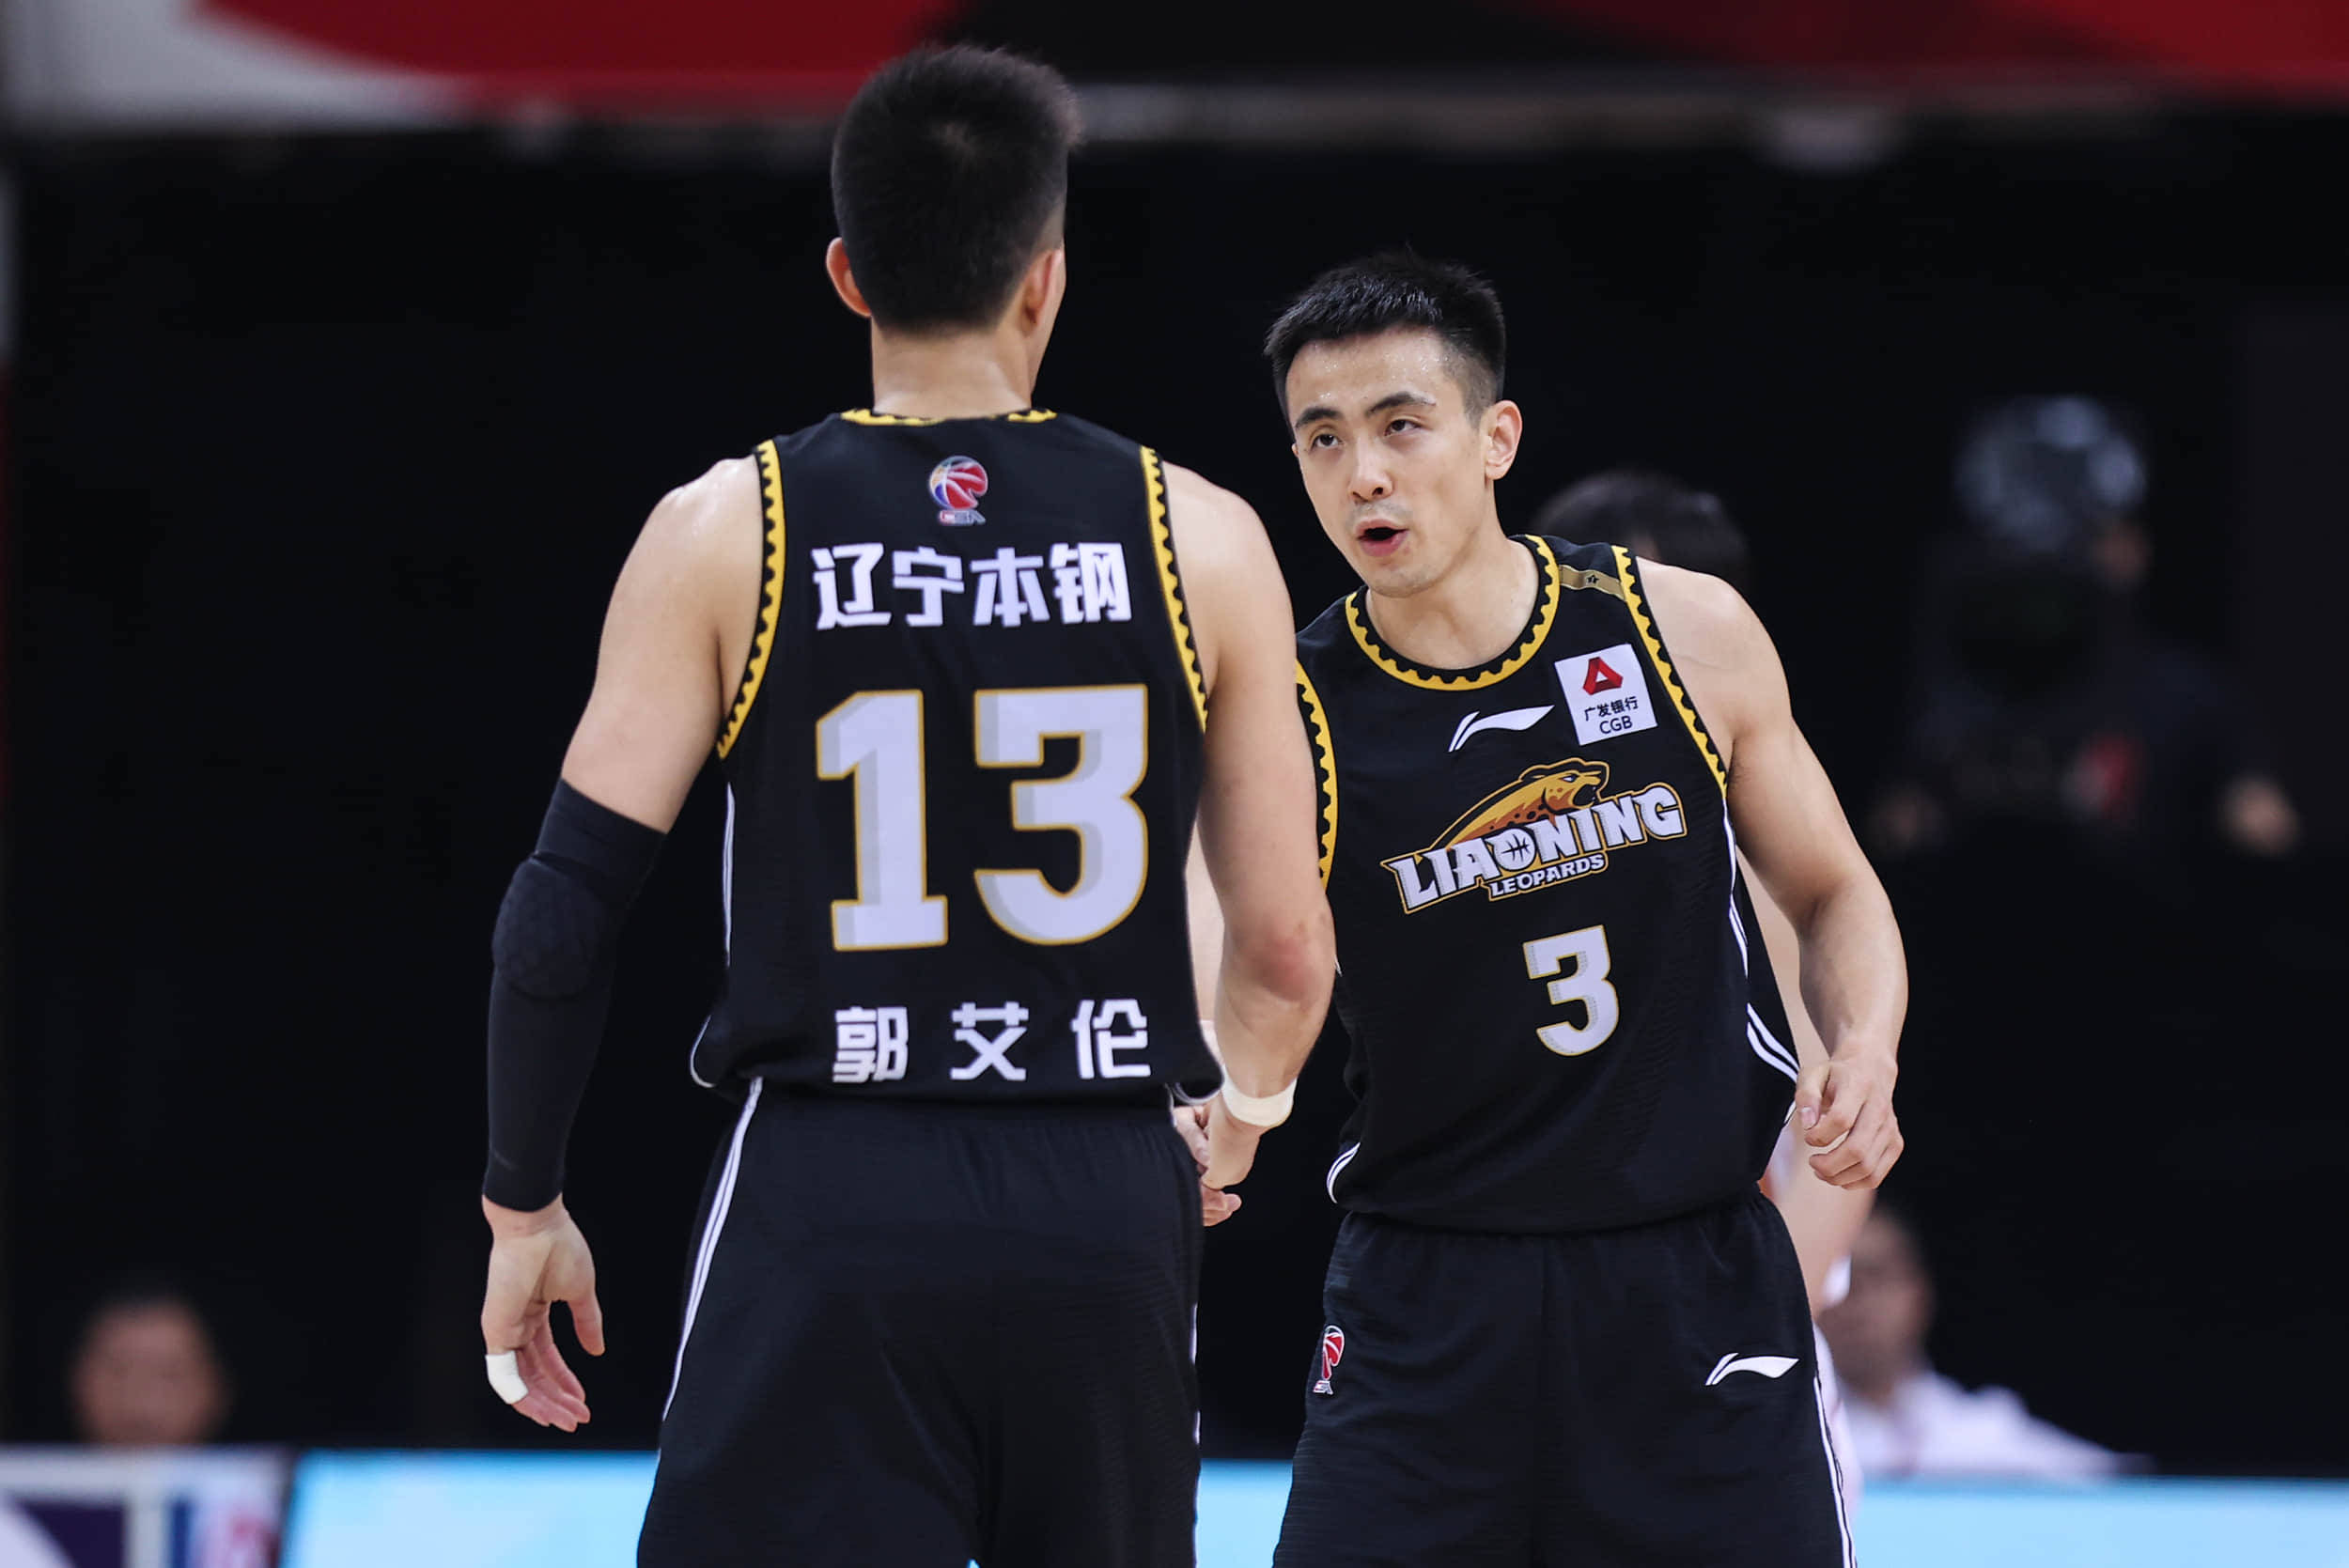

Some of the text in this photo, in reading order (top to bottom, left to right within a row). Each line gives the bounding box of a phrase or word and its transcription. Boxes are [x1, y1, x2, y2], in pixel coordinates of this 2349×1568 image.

[811, 542, 1132, 630] 辽宁本钢
[1584, 696, 1639, 722] 广发银行
[1599, 715, 1633, 735] CGB
[816, 684, 1148, 952] 13
[1389, 784, 1685, 909] LIAONING
[1489, 853, 1606, 897] LEOPARDS
[1522, 924, 1620, 1057] 3
[832, 999, 1151, 1083] 郭艾伦
